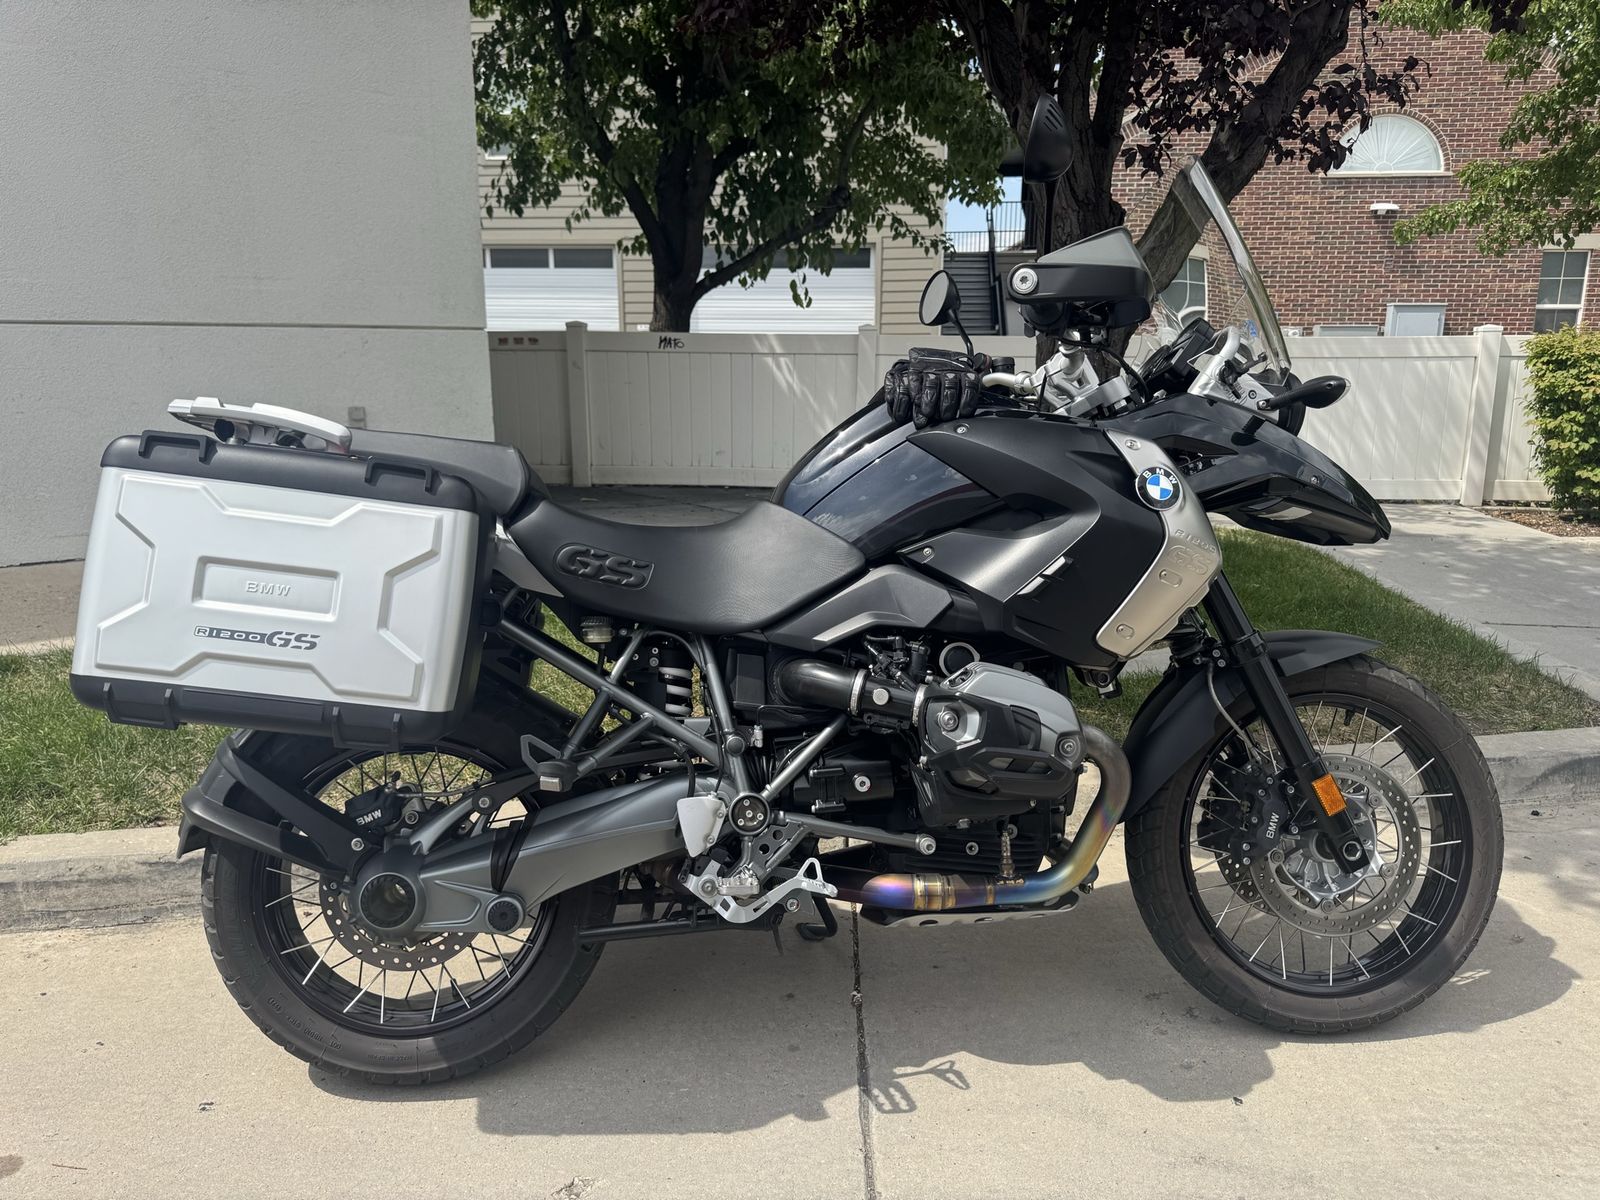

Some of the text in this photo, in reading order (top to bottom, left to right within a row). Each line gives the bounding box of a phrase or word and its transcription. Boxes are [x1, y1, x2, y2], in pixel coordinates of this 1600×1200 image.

[1142, 466, 1178, 485] BMW
[556, 545, 650, 588] GS
[245, 580, 291, 596] BMW
[355, 809, 382, 826] BMW
[1265, 812, 1280, 839] BMW
